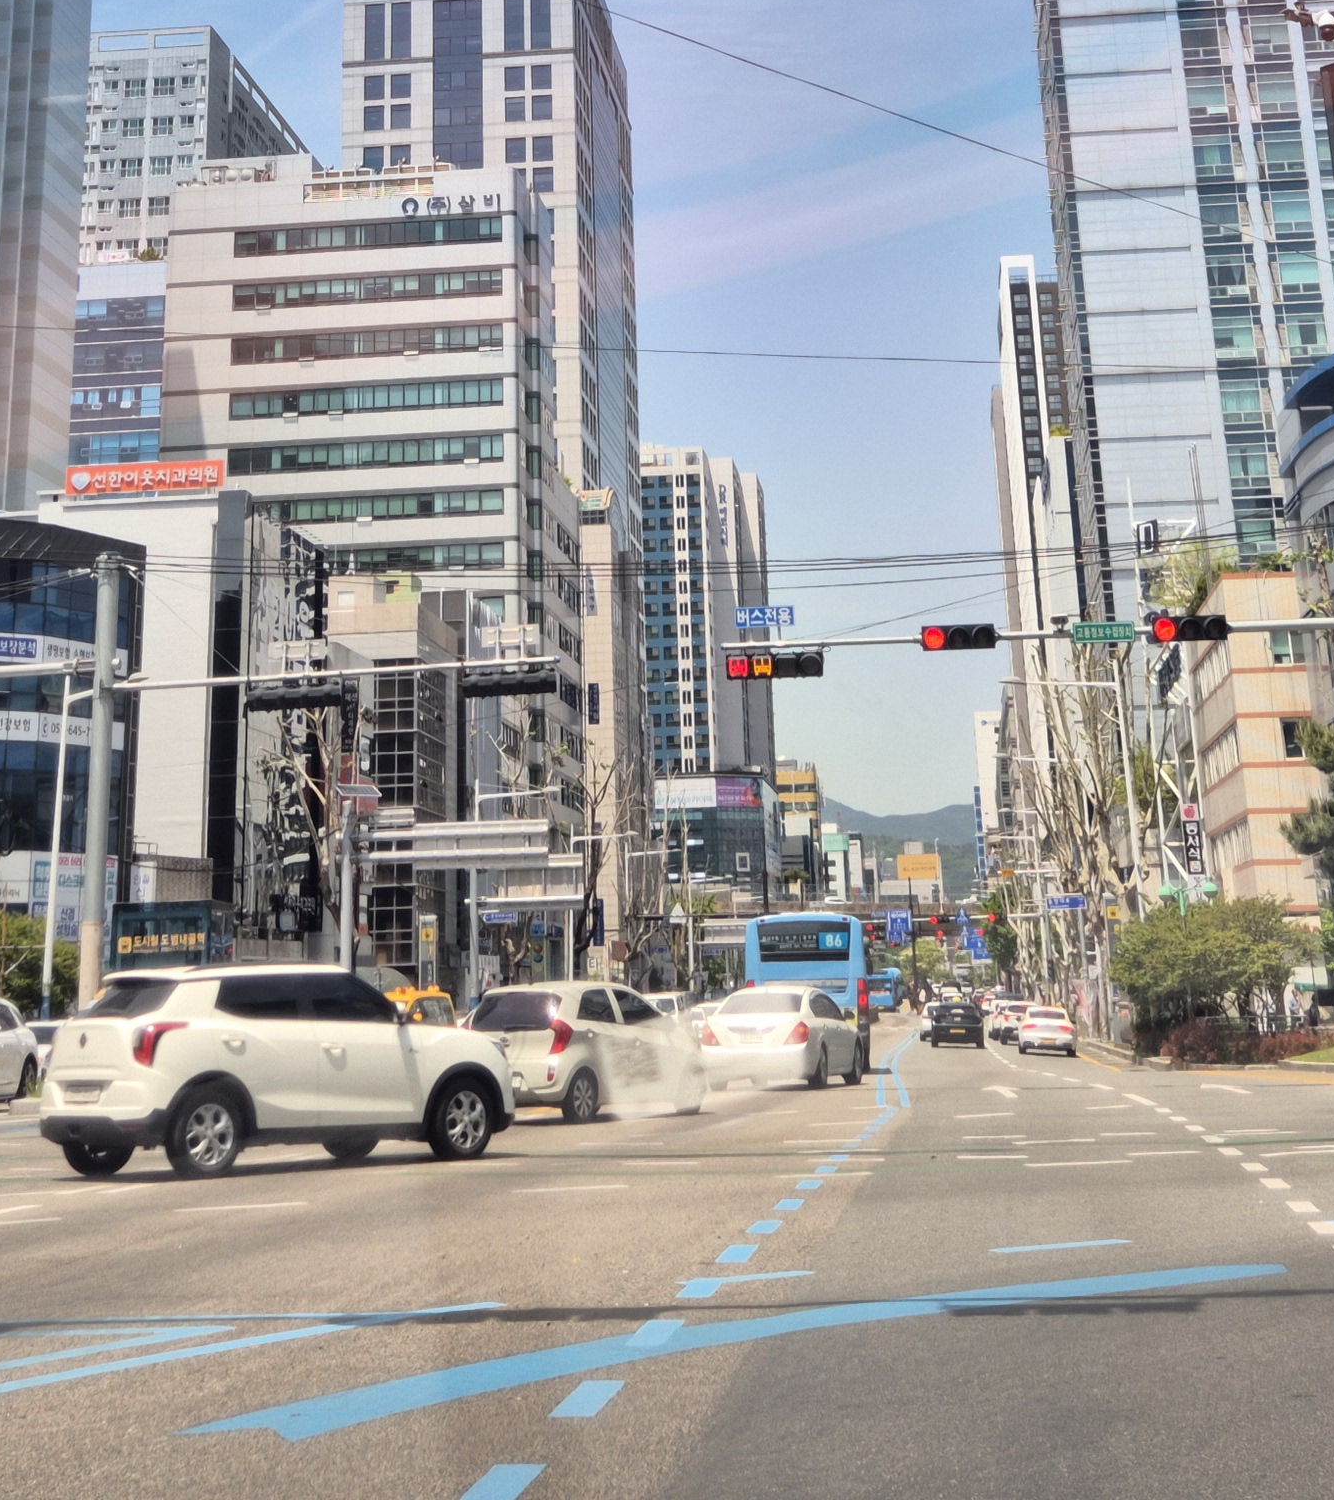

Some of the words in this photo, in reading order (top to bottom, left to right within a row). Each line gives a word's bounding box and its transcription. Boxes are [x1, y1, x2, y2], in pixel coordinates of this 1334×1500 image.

[91, 465, 218, 489] 선한이웃치과의원
[736, 607, 792, 627] 버스전용
[1076, 625, 1133, 639] 교통정보수집장치
[825, 933, 843, 948] 86
